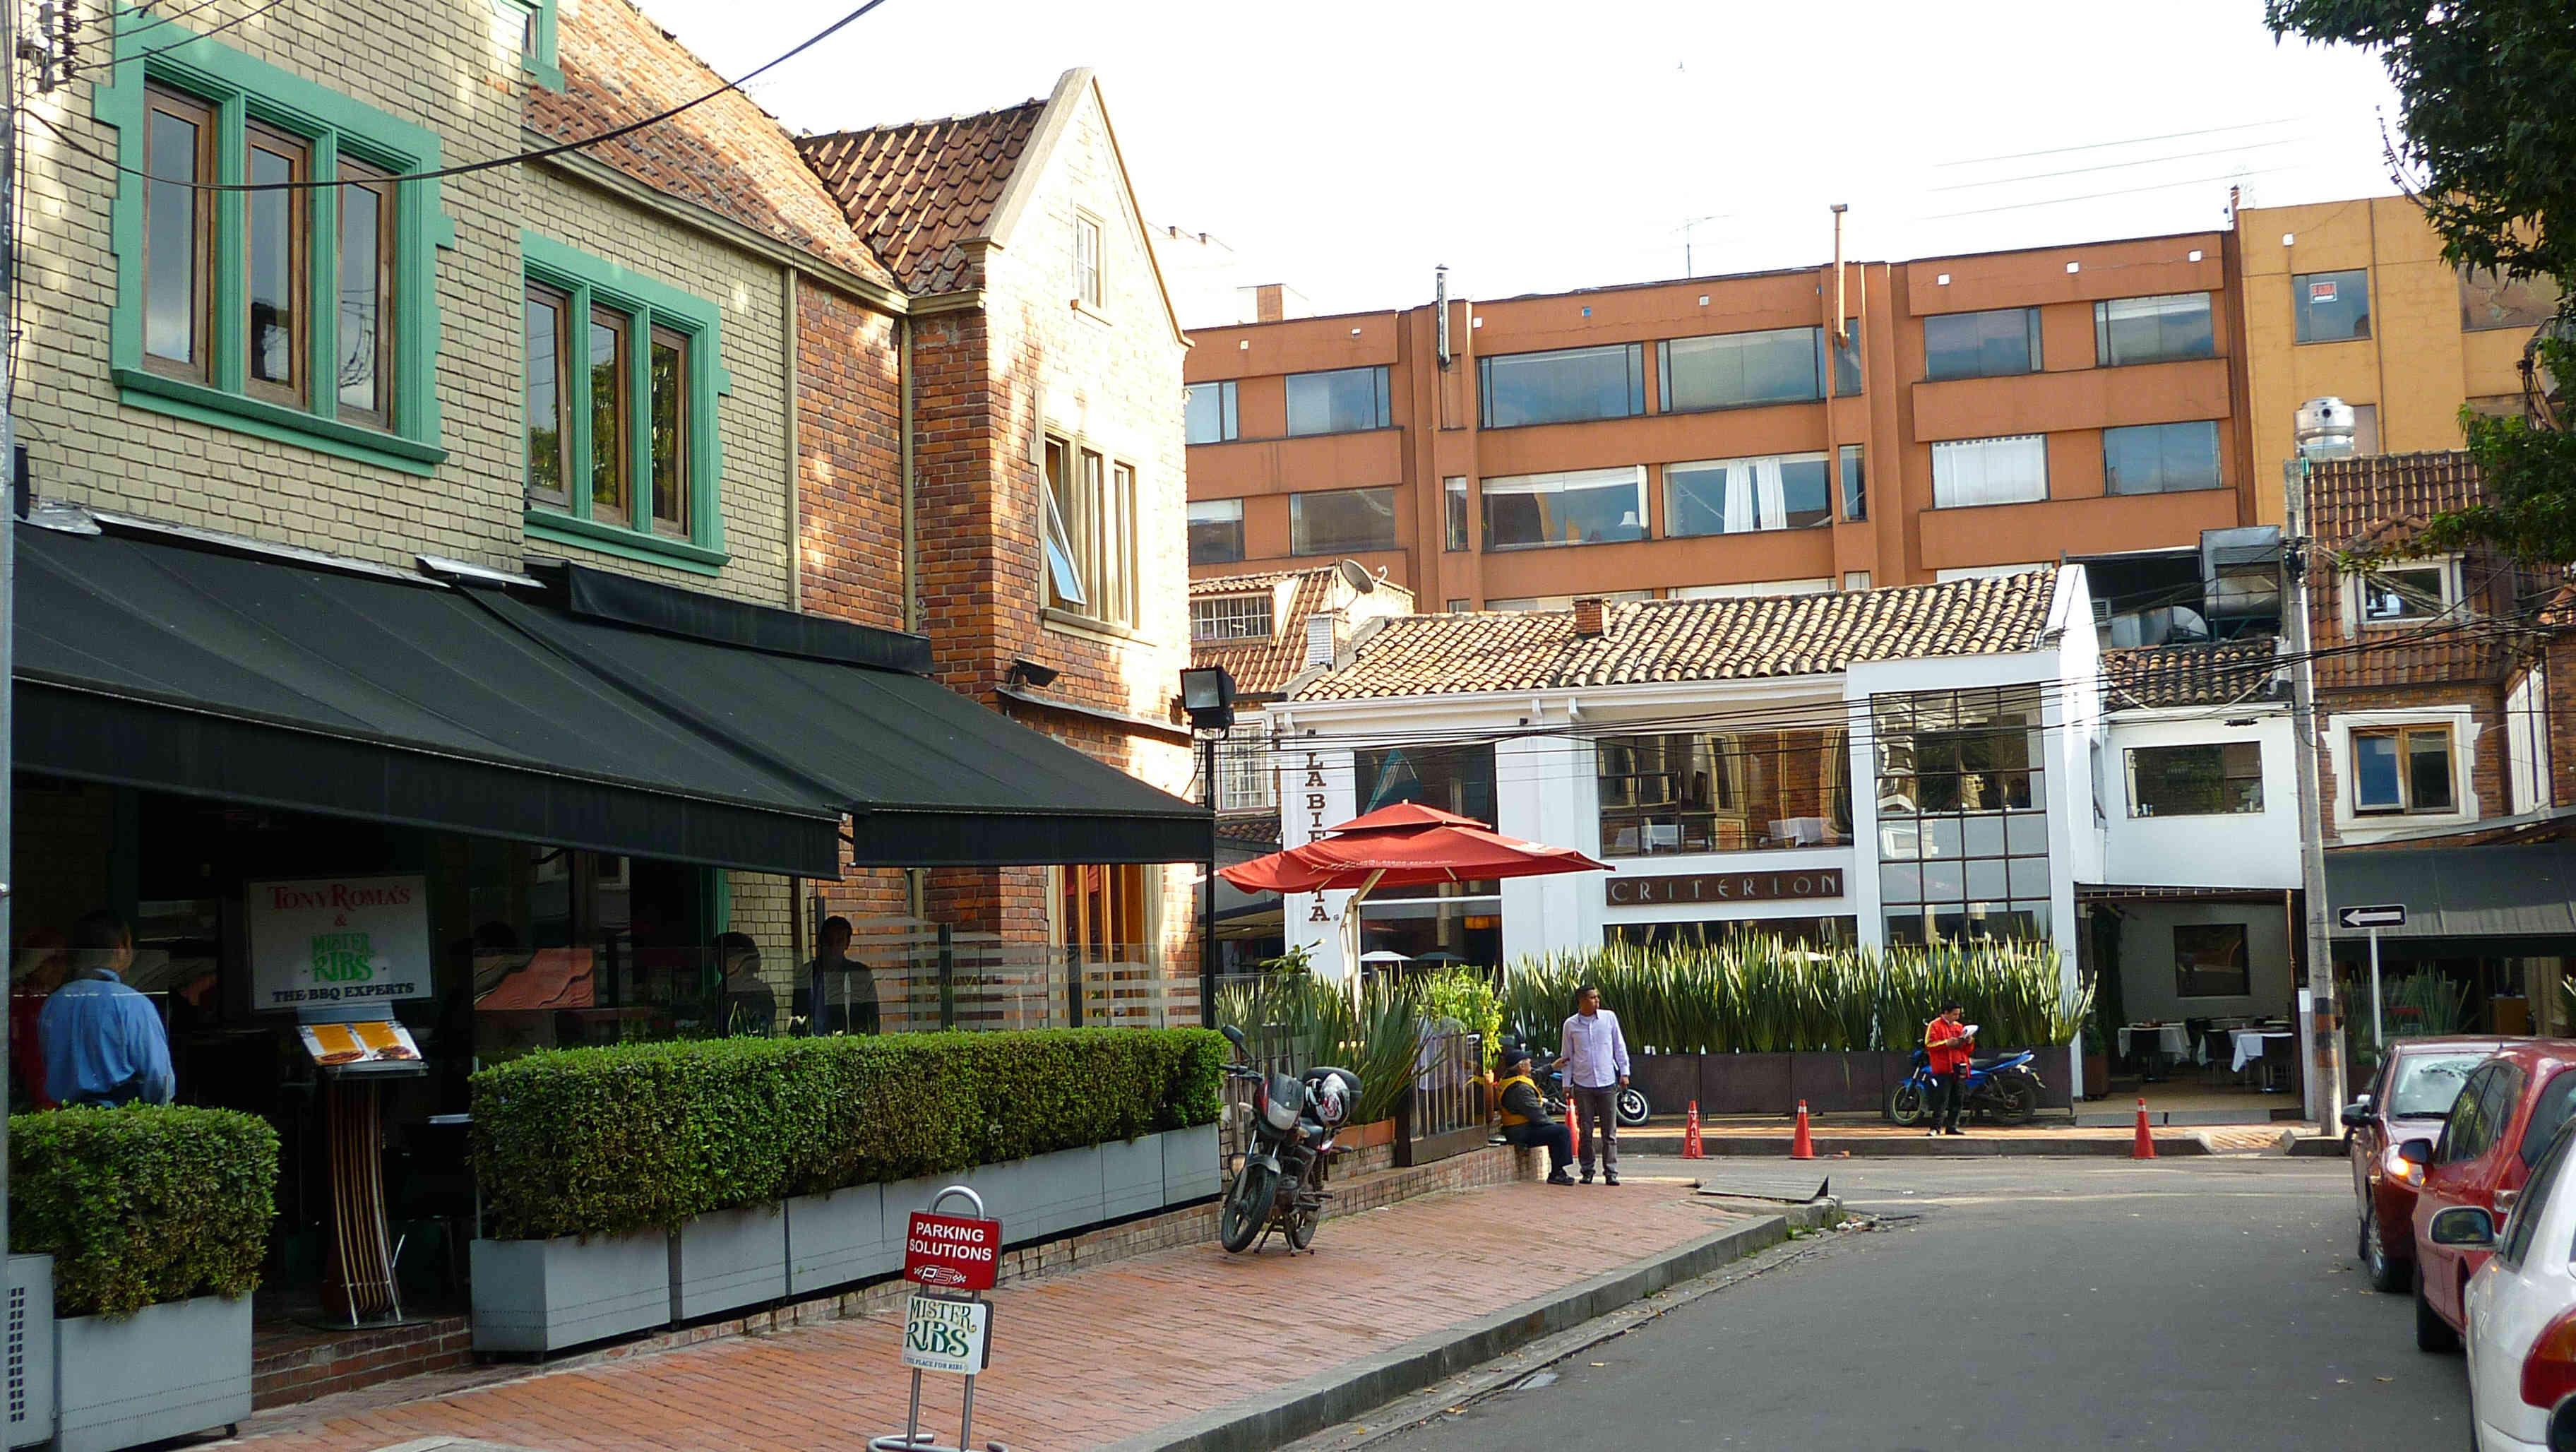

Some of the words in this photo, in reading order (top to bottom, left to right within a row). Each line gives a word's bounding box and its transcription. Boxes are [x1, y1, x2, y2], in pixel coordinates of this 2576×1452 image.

[1305, 752, 1326, 786] LA
[1611, 875, 1836, 902] CRITERION
[311, 932, 376, 956] MISTER
[312, 951, 374, 982] RIBS
[272, 989, 307, 1003] THE
[309, 987, 340, 1001] BBQ
[345, 982, 415, 998] EXPERTS
[916, 1221, 984, 1243] PARKING
[910, 1238, 992, 1261] SOLUTIONS
[909, 1297, 977, 1333] MISTER
[906, 1320, 970, 1357] RIBS
